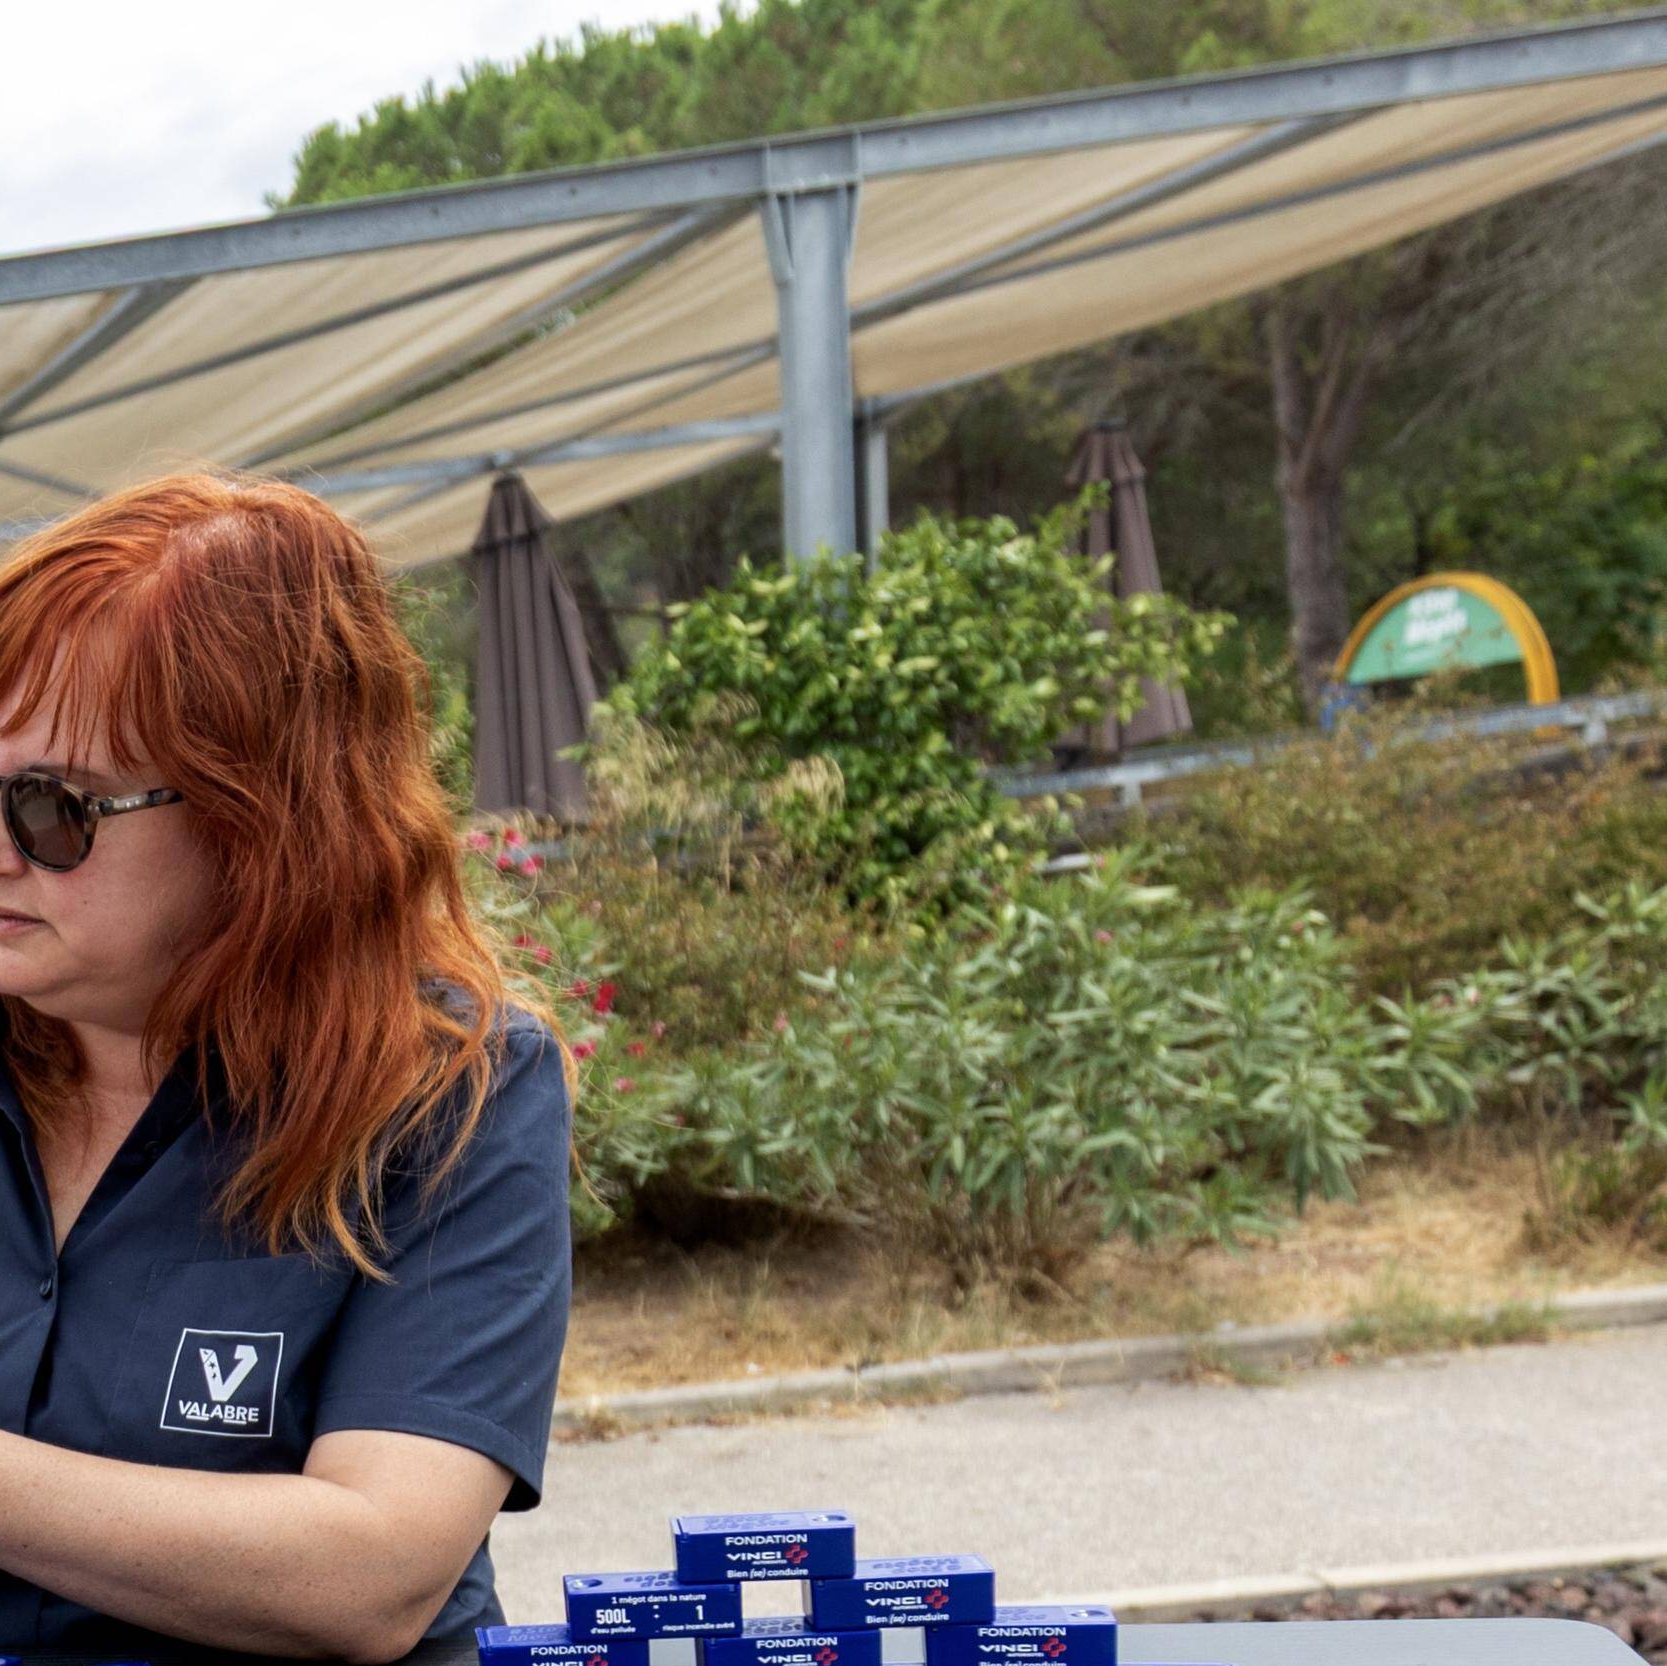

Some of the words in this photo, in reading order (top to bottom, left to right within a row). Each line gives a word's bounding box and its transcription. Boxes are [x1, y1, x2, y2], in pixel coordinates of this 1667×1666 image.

[179, 1400, 259, 1422] VALABRE
[725, 1533, 808, 1546] FONDATION
[726, 1551, 781, 1561] VINCI
[864, 1578, 949, 1592] FONDATION
[865, 1596, 922, 1607] VINCI
[596, 1608, 631, 1625] 500L
[695, 1605, 704, 1621] 1
[977, 1627, 1067, 1638] FONDATION
[756, 1636, 838, 1649] FONDATION
[978, 1644, 1039, 1653] VINCI
[530, 1644, 608, 1656] FONDATION
[757, 1654, 812, 1664] VINCI
